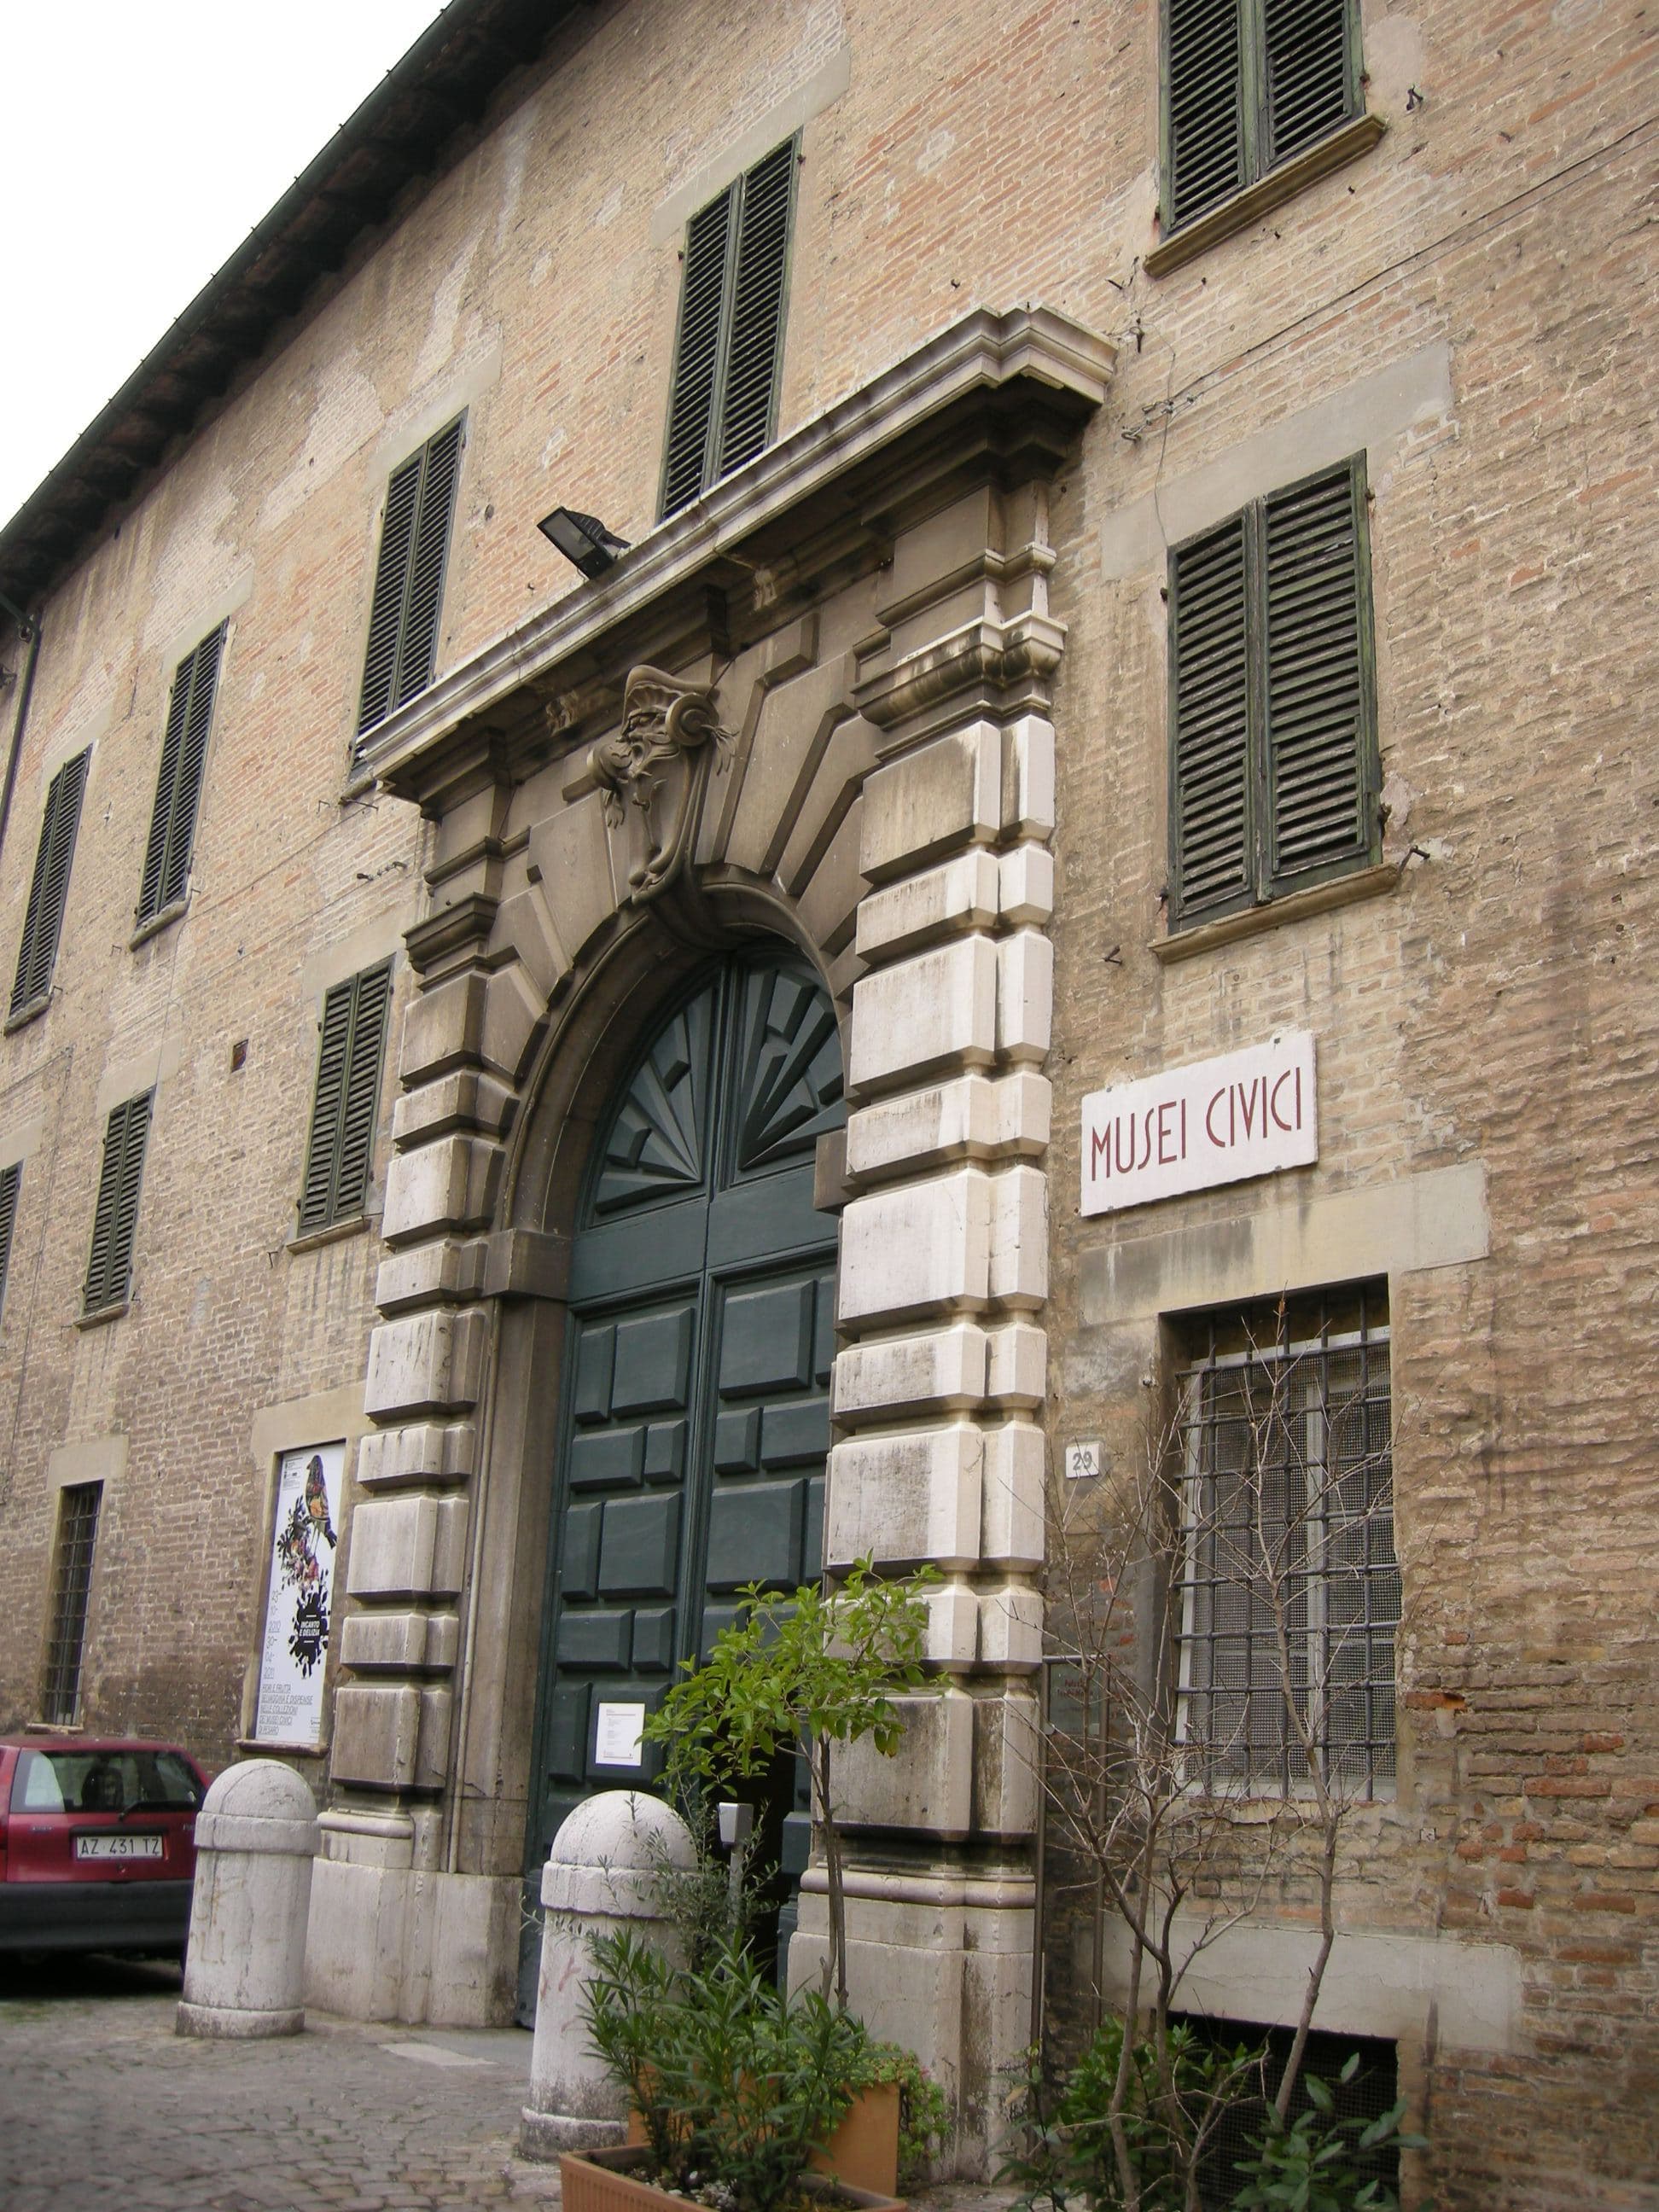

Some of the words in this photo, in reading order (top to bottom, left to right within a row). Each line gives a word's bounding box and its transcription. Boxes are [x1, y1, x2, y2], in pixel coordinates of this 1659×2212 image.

[1091, 1098, 1186, 1181] MUSEI
[1206, 1067, 1301, 1148] CIVICI
[1073, 1451, 1092, 1470] 29
[303, 1628, 320, 1637] DELIZIA
[81, 1838, 99, 1855] AZ
[109, 1838, 134, 1854] 431
[143, 1838, 160, 1855] TZ
